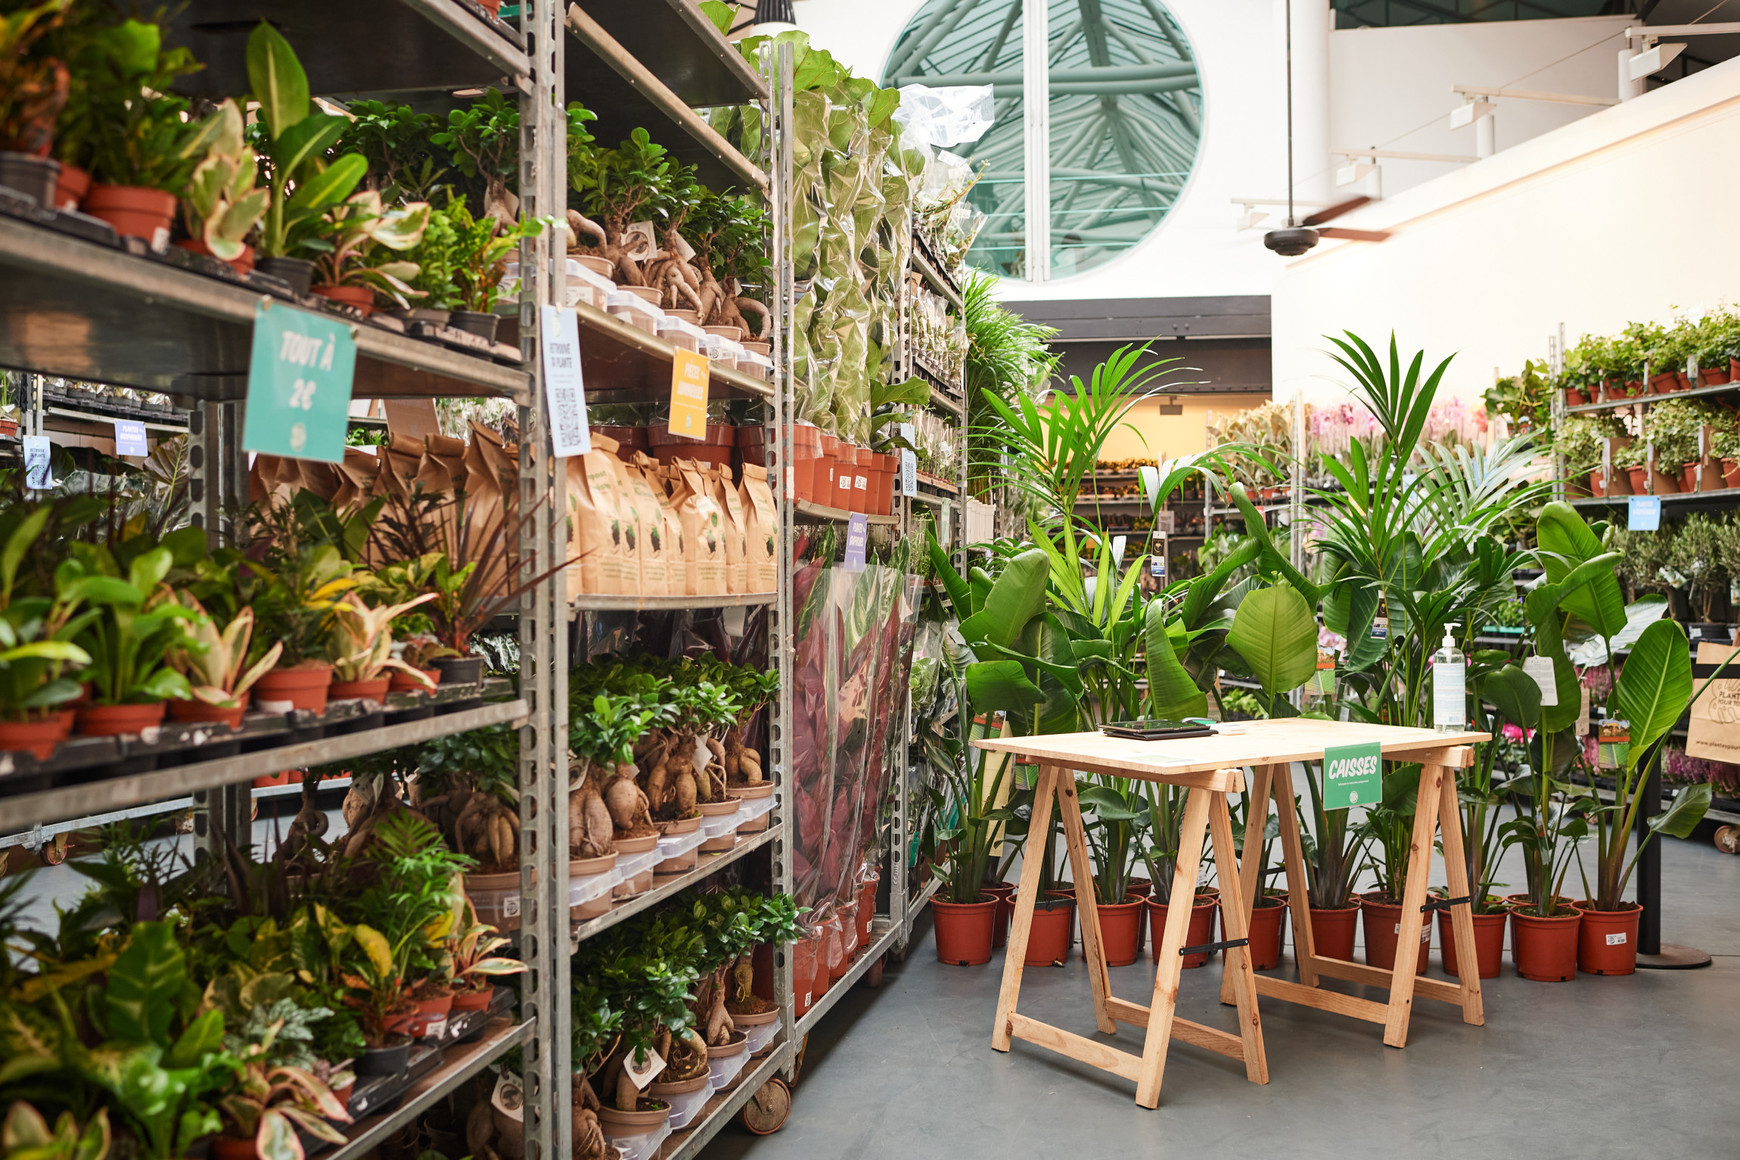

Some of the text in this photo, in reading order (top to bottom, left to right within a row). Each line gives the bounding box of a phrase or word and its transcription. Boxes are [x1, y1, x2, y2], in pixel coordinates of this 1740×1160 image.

[280, 330, 336, 372] TOUT À
[289, 378, 316, 411] 2€
[1328, 755, 1377, 779] CAISSES
